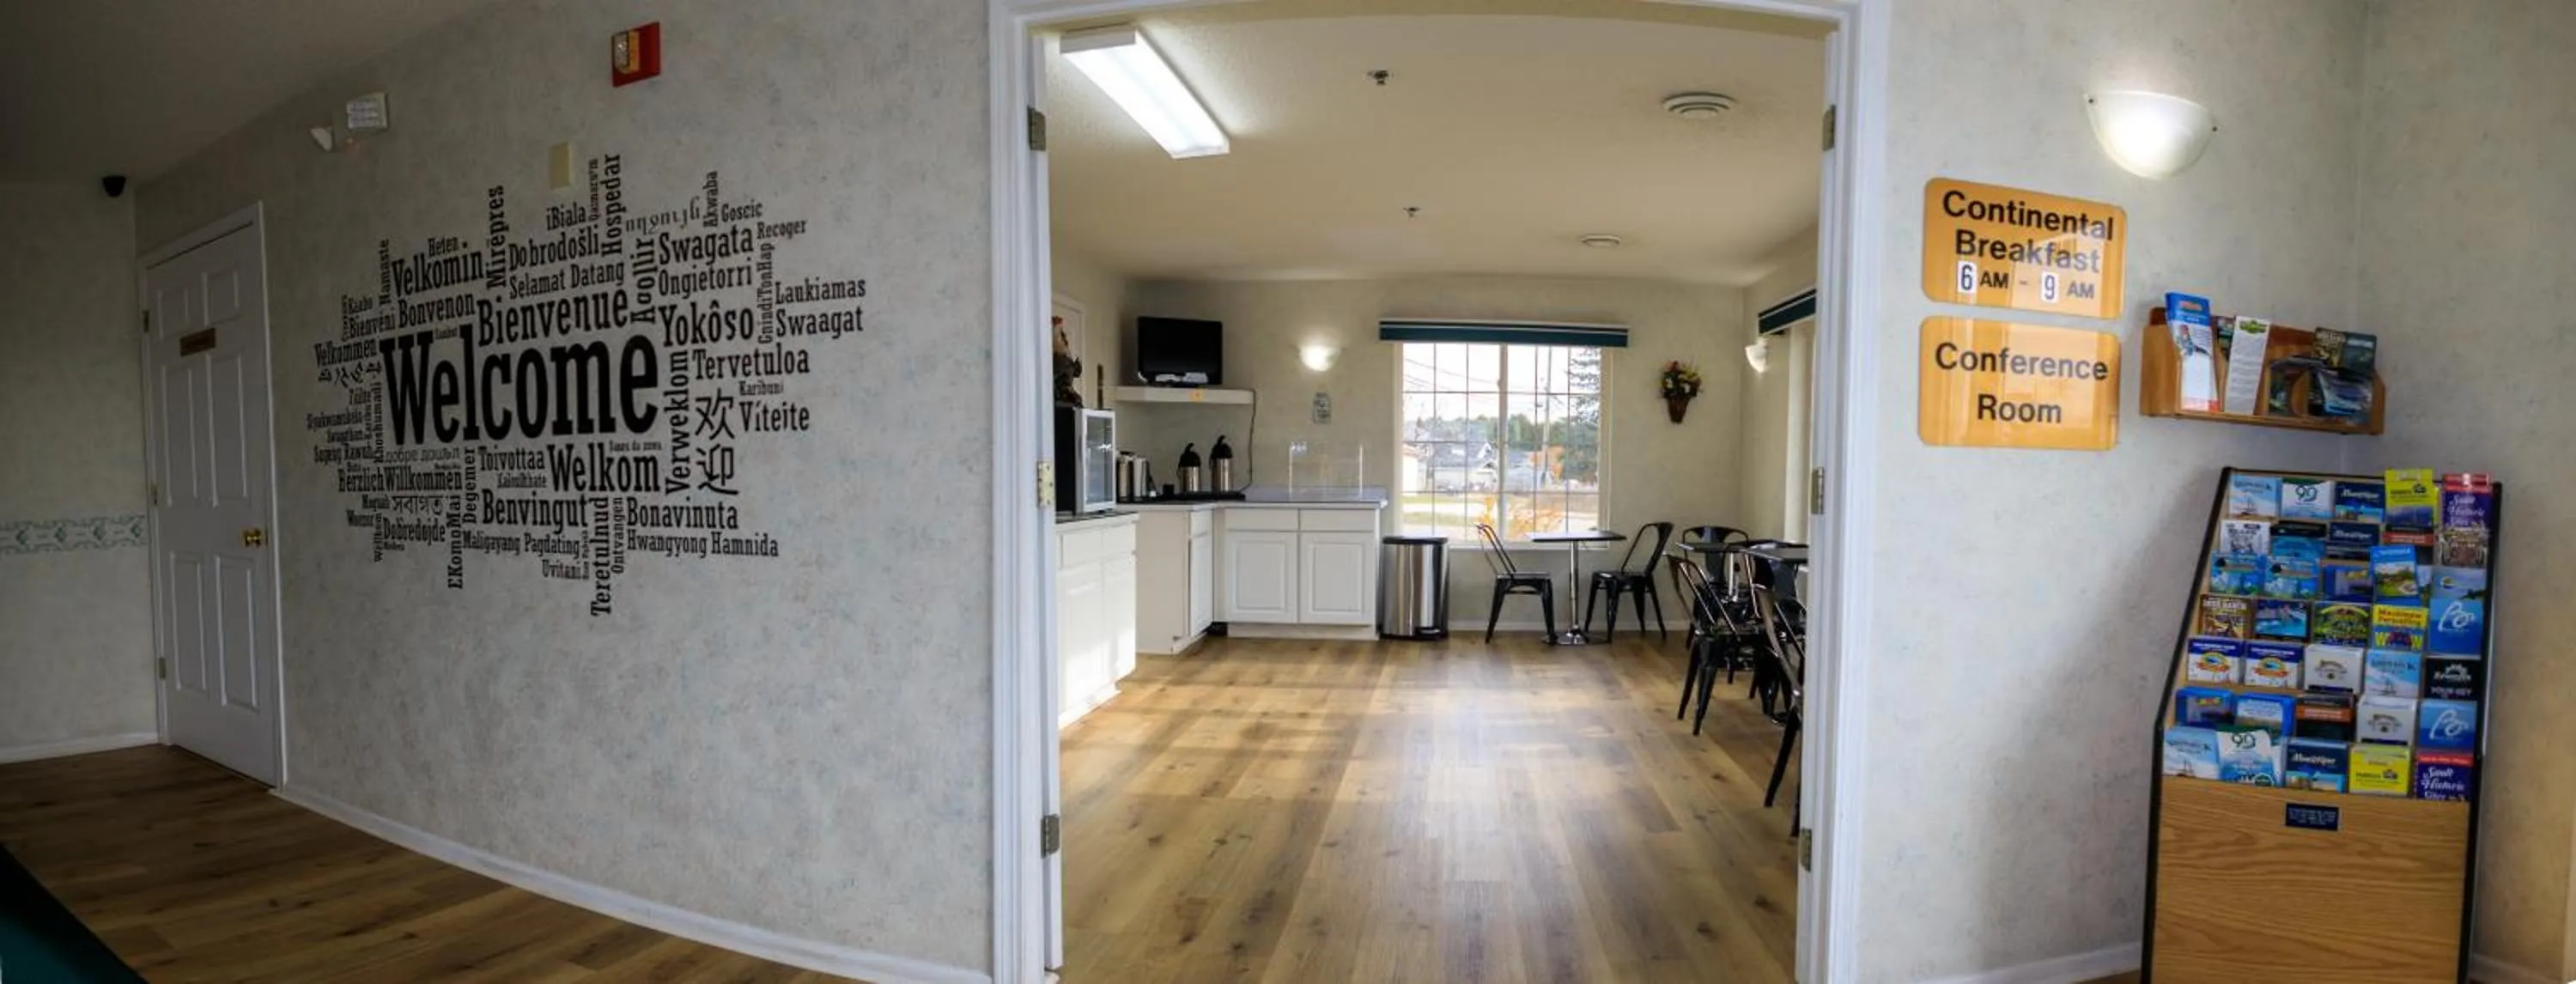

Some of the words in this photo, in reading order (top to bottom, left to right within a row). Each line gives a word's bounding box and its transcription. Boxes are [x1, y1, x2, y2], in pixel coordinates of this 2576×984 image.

[600, 154, 626, 257] Hospedar
[702, 171, 719, 228] Akwaba
[1942, 190, 2113, 241] Continental
[508, 224, 600, 271] Dobrodošli
[659, 225, 754, 265] Swagata
[756, 220, 807, 240] Recoger
[1955, 228, 2100, 274] Breakfast
[379, 239, 392, 307] Namaste
[392, 241, 483, 297] Velkomin
[509, 269, 567, 300] Selamat
[570, 260, 625, 289] Datang
[658, 257, 753, 299] Ongietorri
[775, 277, 866, 305] Laukiamas
[1961, 264, 1973, 291] 6
[1979, 271, 2009, 289] AM
[2044, 274, 2056, 301] 9
[2066, 282, 2095, 300] AM
[398, 293, 477, 329] Bonvenon
[477, 290, 629, 347] Bienvenue
[658, 299, 754, 347] Yokôso
[776, 305, 863, 339] Swaagat
[380, 323, 659, 446] Welcome
[692, 342, 811, 380] Tervetuloa
[1935, 341, 2109, 381] Conference
[663, 349, 690, 495] Verweklom
[1977, 392, 2063, 424] Room
[477, 444, 546, 472] Toivottaa
[694, 387, 739, 495] 欢迎
[337, 466, 385, 493] Herzlich
[384, 465, 463, 492] Willkommen
[462, 447, 480, 525] Degemer
[547, 442, 660, 493] Welkom
[482, 488, 588, 535] Benvingut
[627, 496, 739, 531] Bonavinuta
[447, 494, 464, 590] EKomoMai
[589, 496, 612, 617] Teretulnud
[611, 497, 625, 575] Ontvangen
[627, 529, 707, 559] Hwangyong
[710, 531, 780, 558] Hamnida
